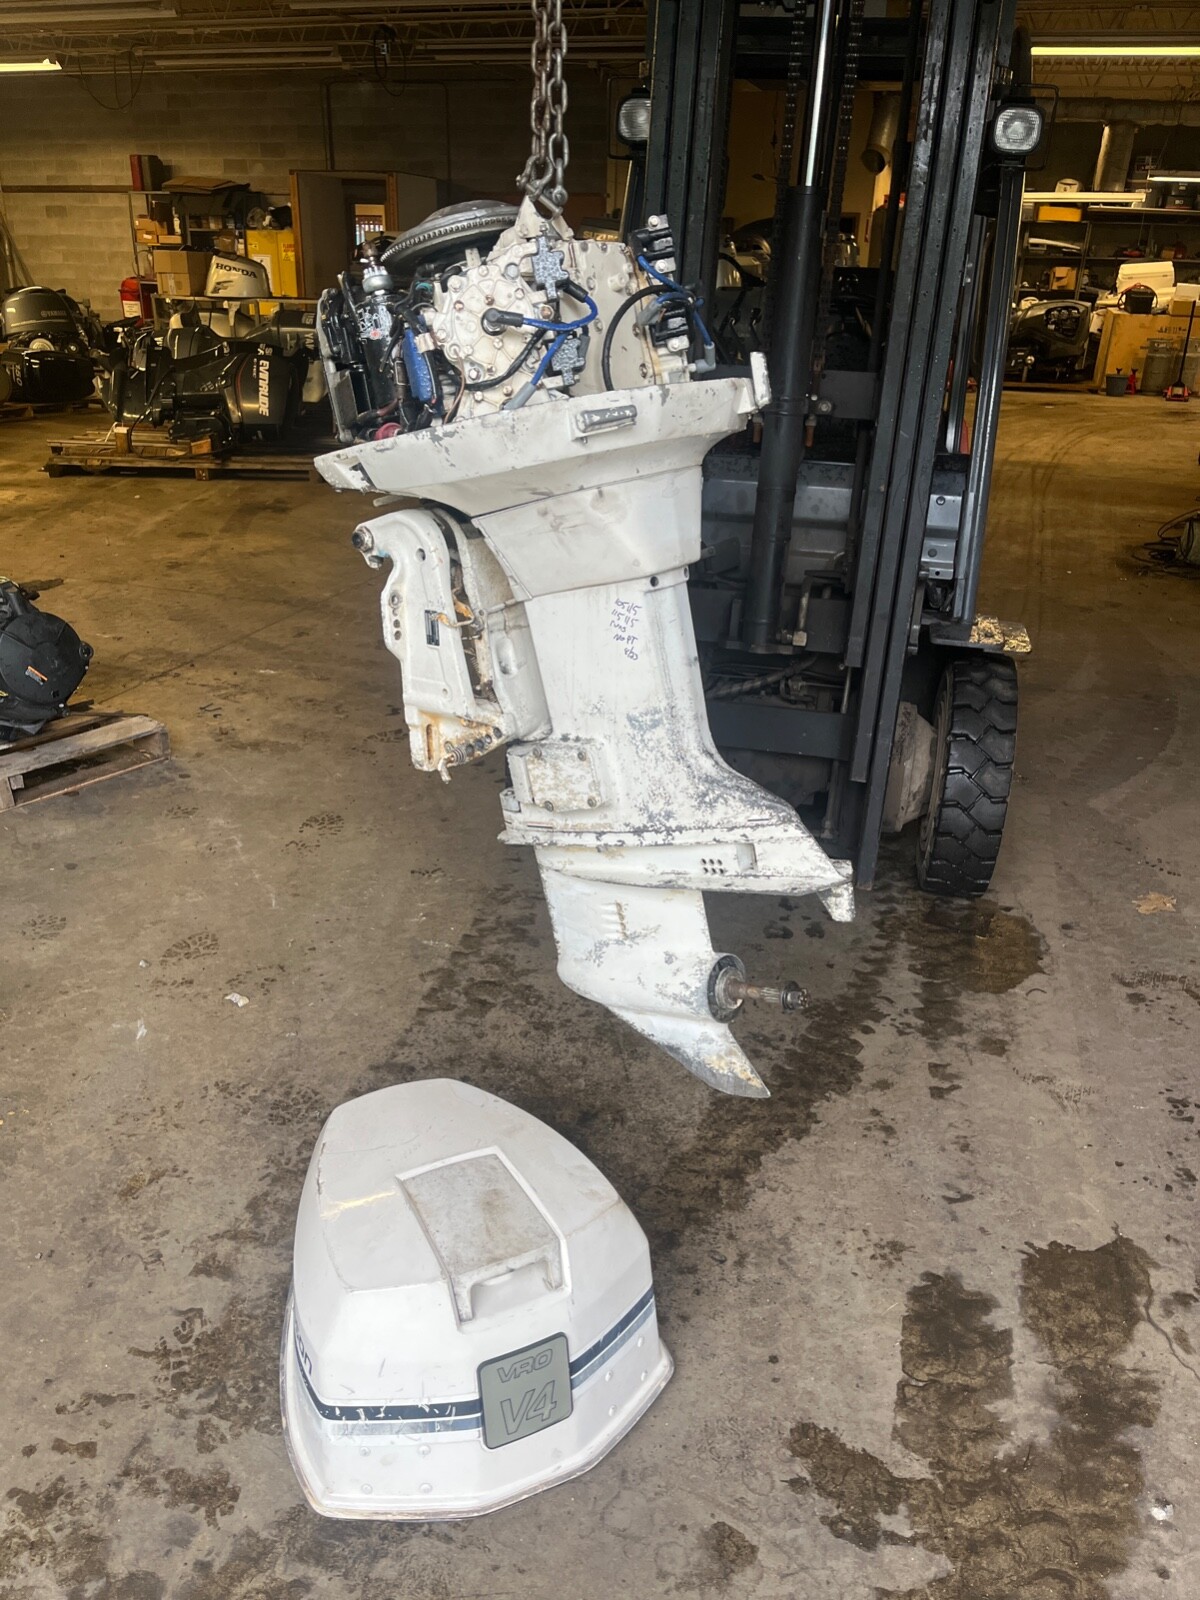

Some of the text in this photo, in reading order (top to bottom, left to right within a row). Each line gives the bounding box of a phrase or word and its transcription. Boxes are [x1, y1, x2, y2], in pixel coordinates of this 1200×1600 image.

[215, 263, 257, 278] HONDA
[258, 360, 270, 417] EVINRUDE
[497, 1348, 553, 1383] VRO
[500, 1380, 557, 1435] V4
